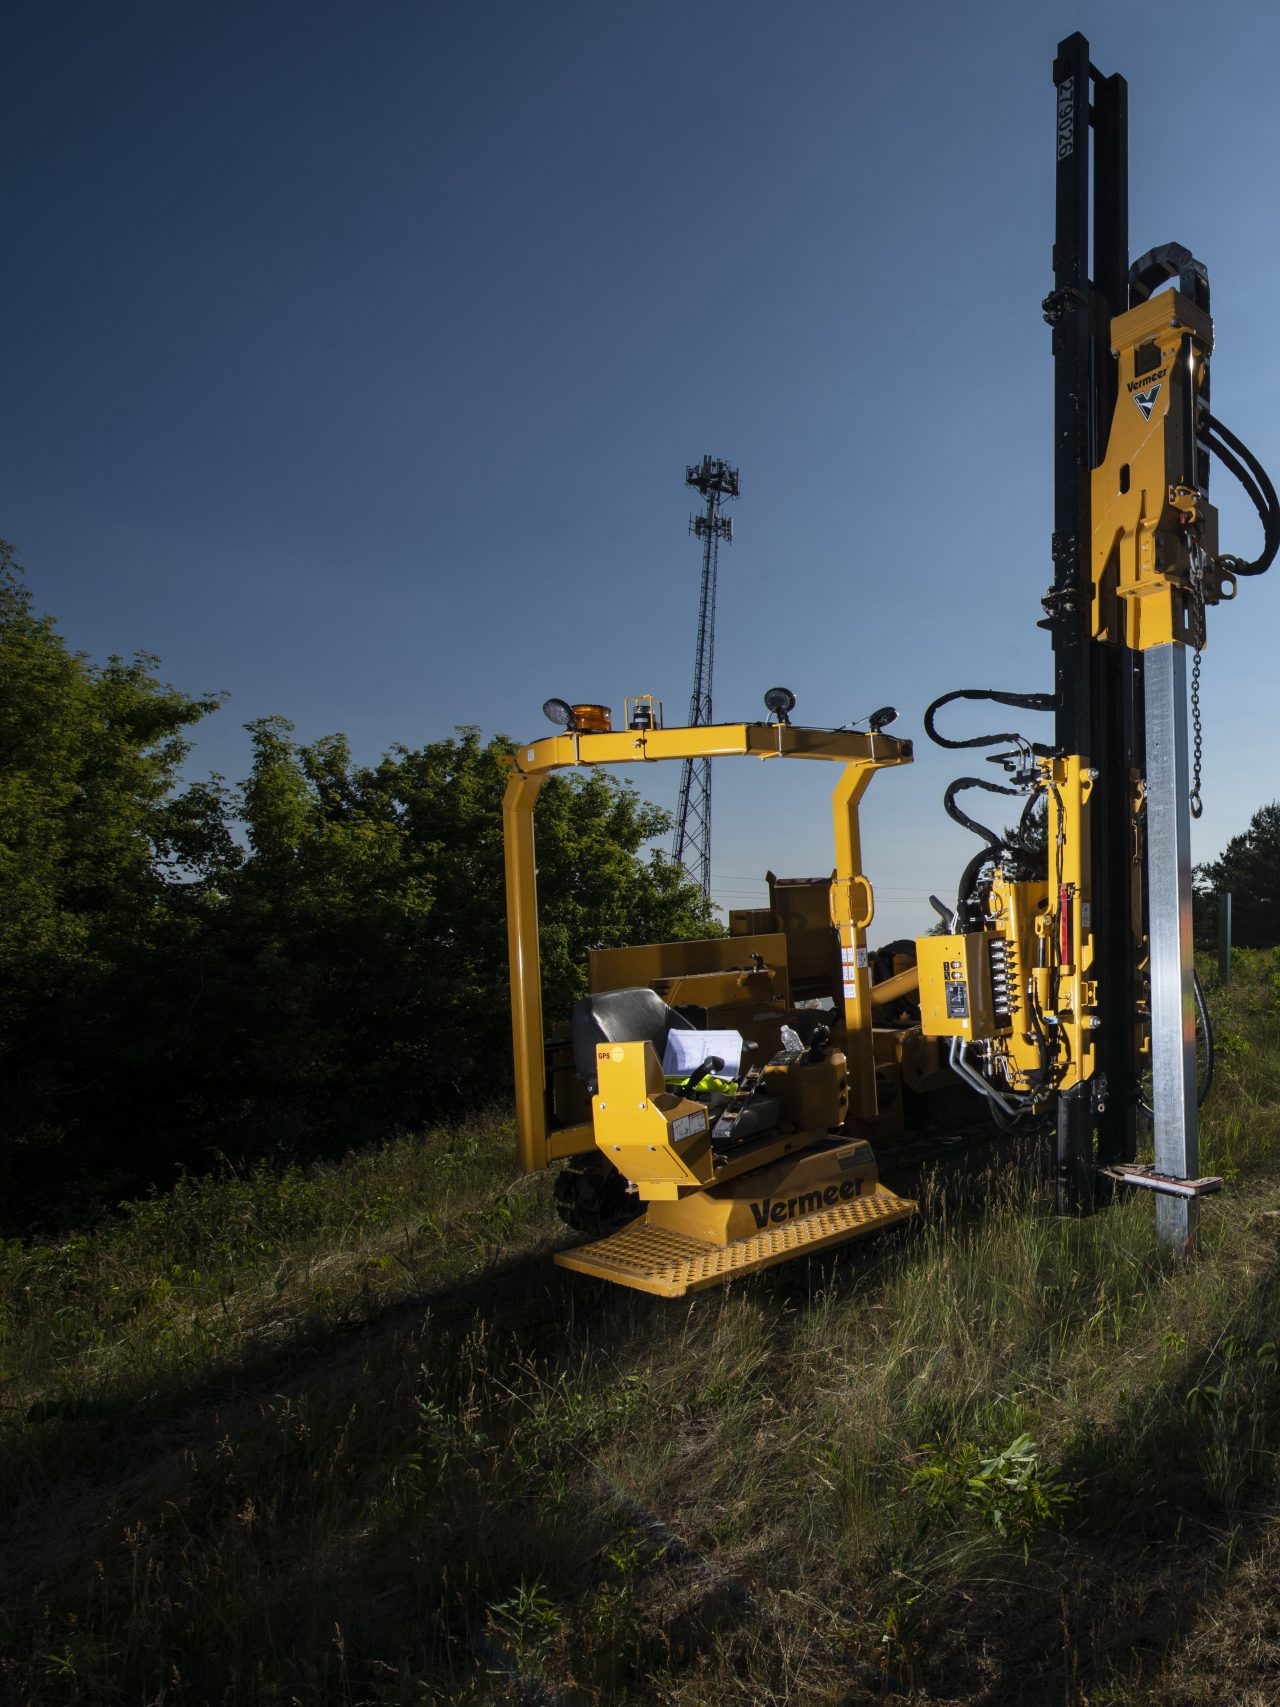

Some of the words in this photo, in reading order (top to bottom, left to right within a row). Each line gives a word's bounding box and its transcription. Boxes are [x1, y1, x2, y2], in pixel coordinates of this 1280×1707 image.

[1058, 79, 1073, 157] 279026
[1127, 367, 1168, 392] Vermeer
[598, 1052, 610, 1060] GPS
[749, 1176, 864, 1229] Vermeer
